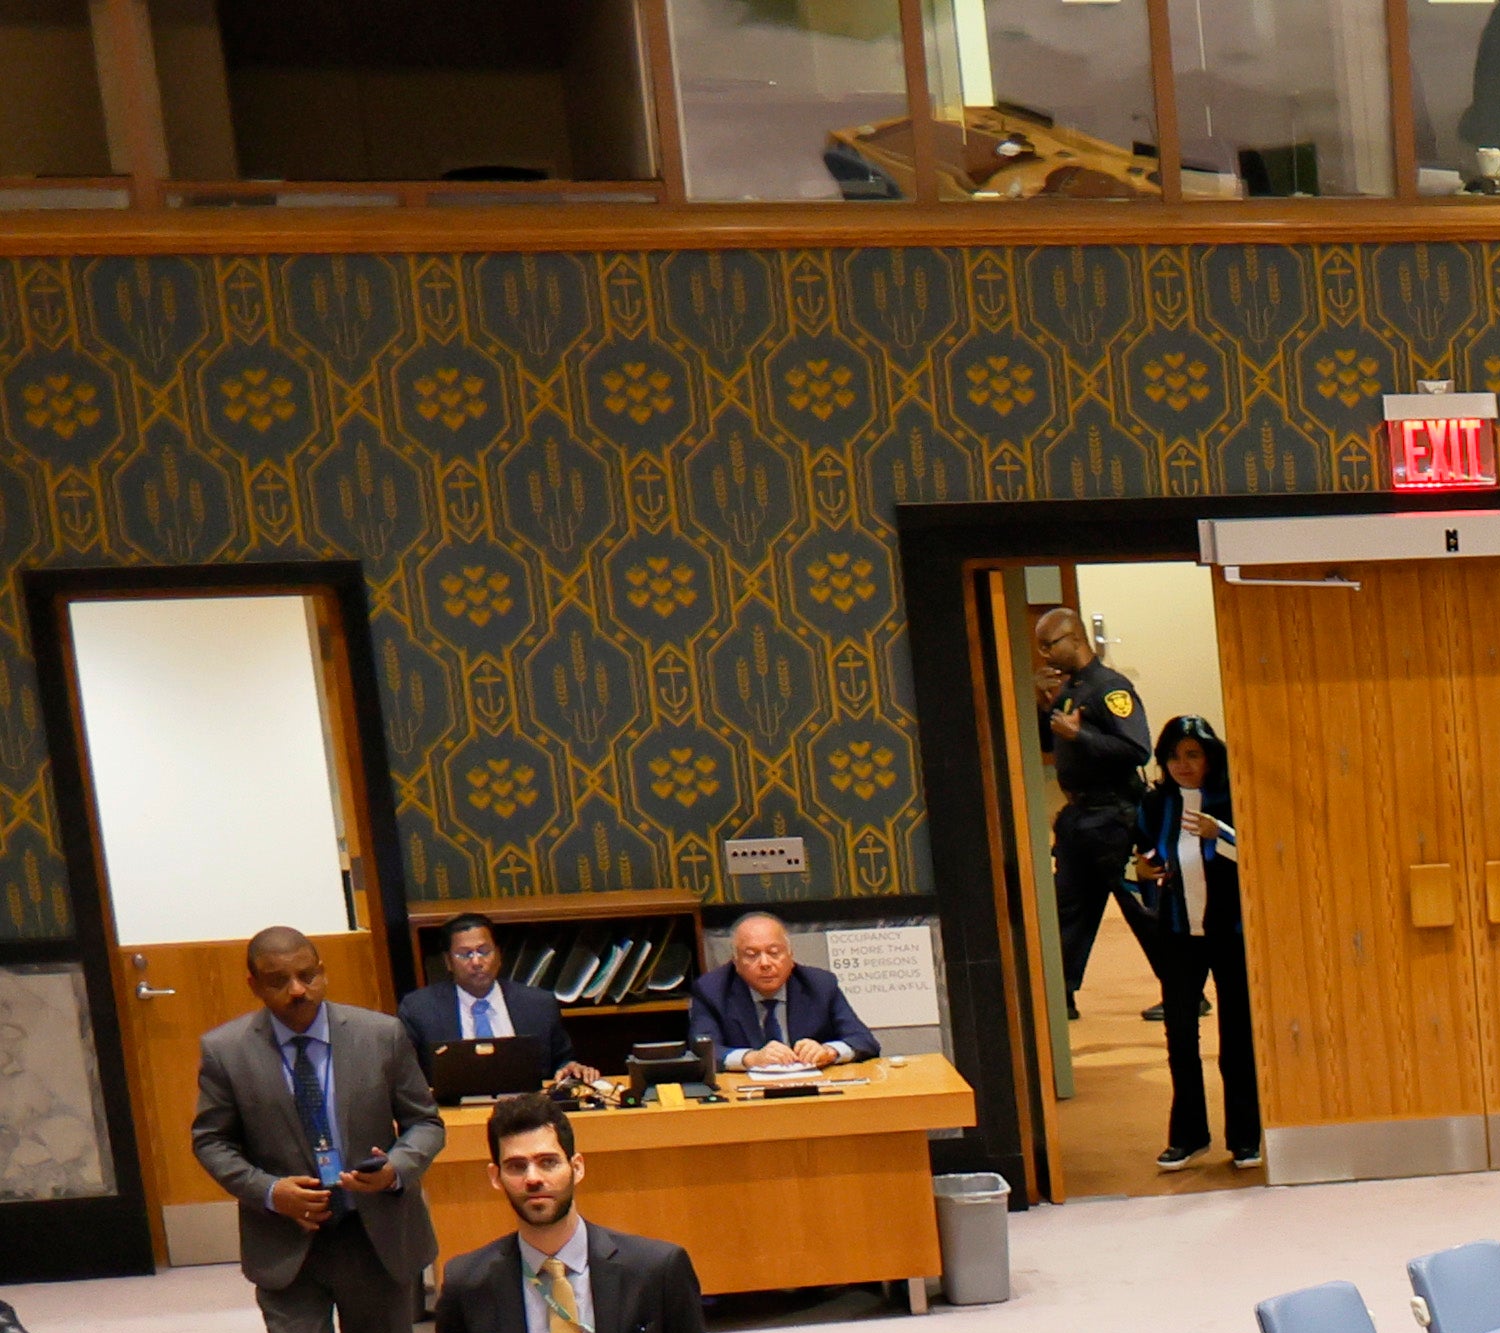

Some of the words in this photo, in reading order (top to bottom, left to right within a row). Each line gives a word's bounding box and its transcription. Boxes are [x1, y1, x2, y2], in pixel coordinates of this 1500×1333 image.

[1403, 419, 1481, 481] EXIT
[830, 931, 902, 944] OCCUPANCY
[832, 948, 846, 957] BY
[850, 945, 884, 956] MORE
[888, 944, 920, 953] THAN
[833, 958, 860, 969] 693
[863, 956, 918, 967] PERSONS
[848, 969, 921, 982] DANGEROUS
[844, 985, 862, 994] ND
[865, 983, 931, 994] UNLAWFUL
